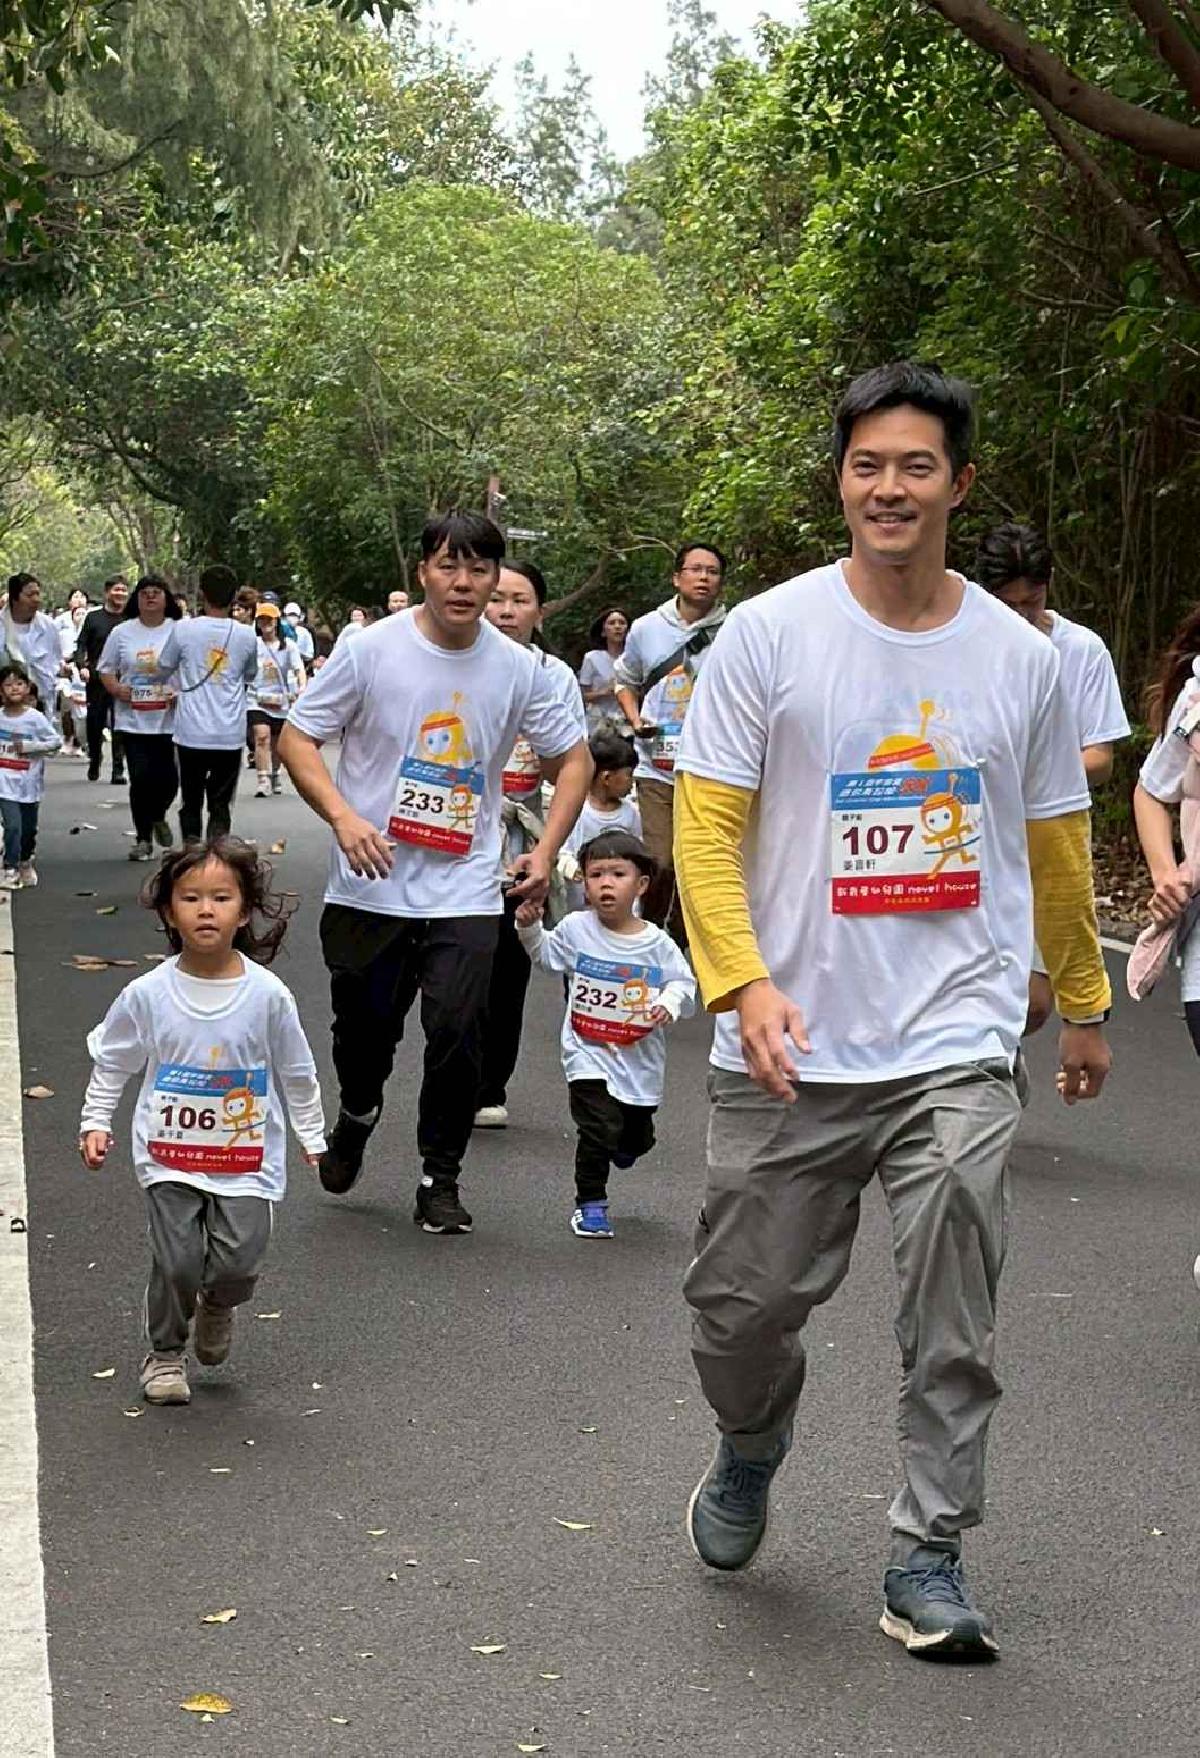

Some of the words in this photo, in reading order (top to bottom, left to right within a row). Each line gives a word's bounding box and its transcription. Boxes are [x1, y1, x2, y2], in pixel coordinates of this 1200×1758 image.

[400, 788, 444, 814] 233
[842, 825, 914, 855] 107
[908, 884, 940, 894] novel
[944, 882, 977, 893] house
[575, 985, 618, 1009] 232
[160, 1104, 216, 1130] 106
